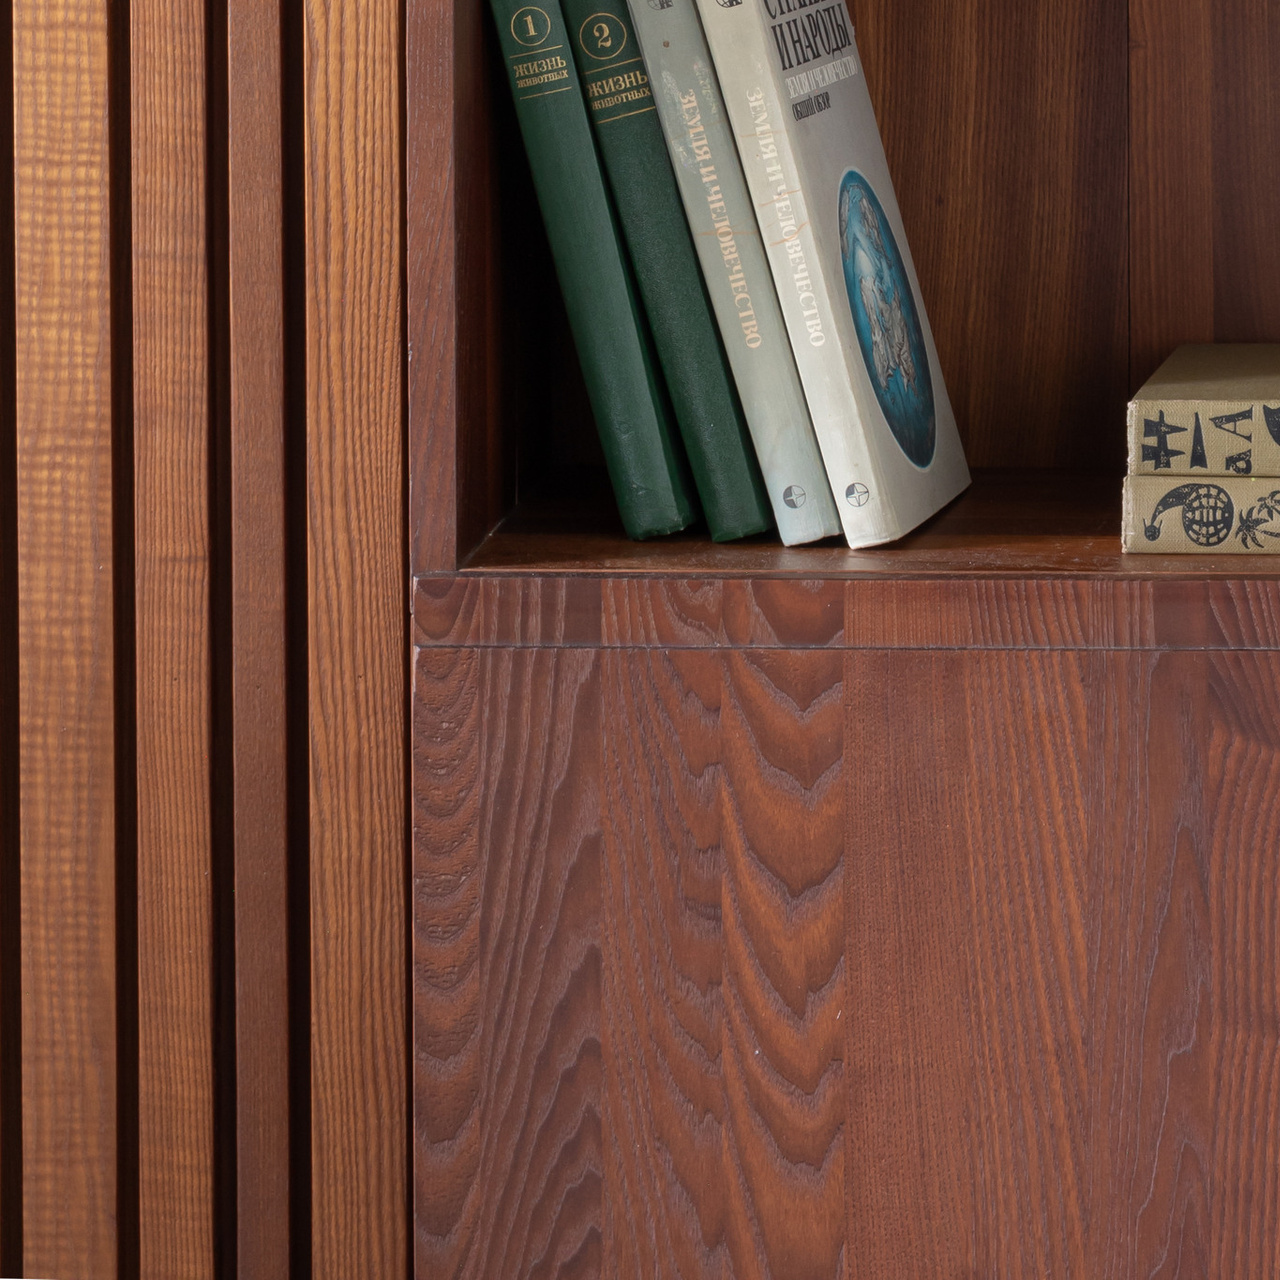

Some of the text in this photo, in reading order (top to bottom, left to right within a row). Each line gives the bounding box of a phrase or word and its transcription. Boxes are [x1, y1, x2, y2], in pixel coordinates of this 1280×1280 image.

[523, 14, 538, 37] 1
[593, 22, 612, 49] 2
[771, 3, 852, 71] И НАРОДЫ
[513, 55, 567, 78] ЖИЗНЬ
[586, 70, 648, 98] ЖИЗНЬ
[679, 89, 762, 349] ЗЕМЛЯ И ЧЕЛОВЕЧЕСТВО
[745, 87, 826, 348] ЗЕМЛЯ И ЧЕЛОВЕЧЕСТВО
